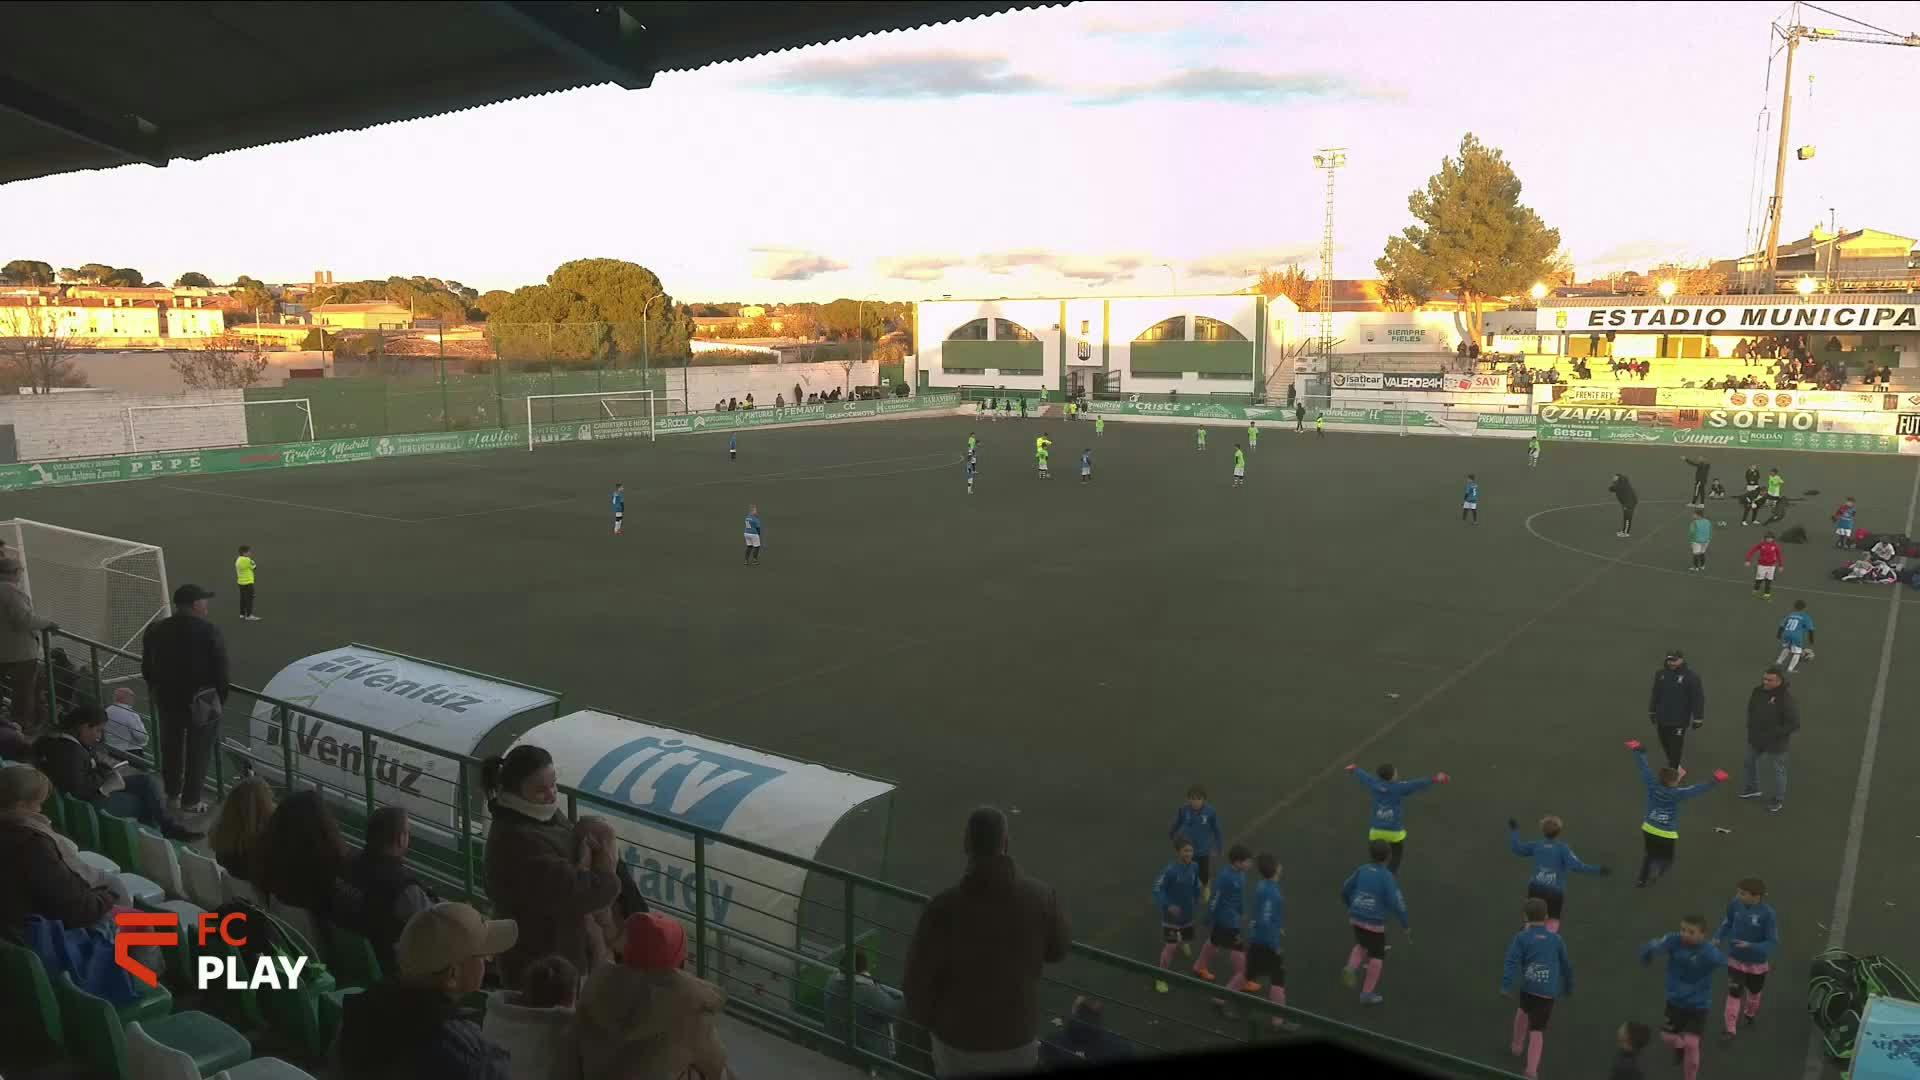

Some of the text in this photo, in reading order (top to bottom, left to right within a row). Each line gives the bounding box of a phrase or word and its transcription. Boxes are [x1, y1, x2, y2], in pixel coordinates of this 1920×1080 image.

[1587, 308, 1728, 327] ESTADIO
[1559, 406, 1639, 422] ZAPATA
[1708, 410, 1815, 430] SOFIO
